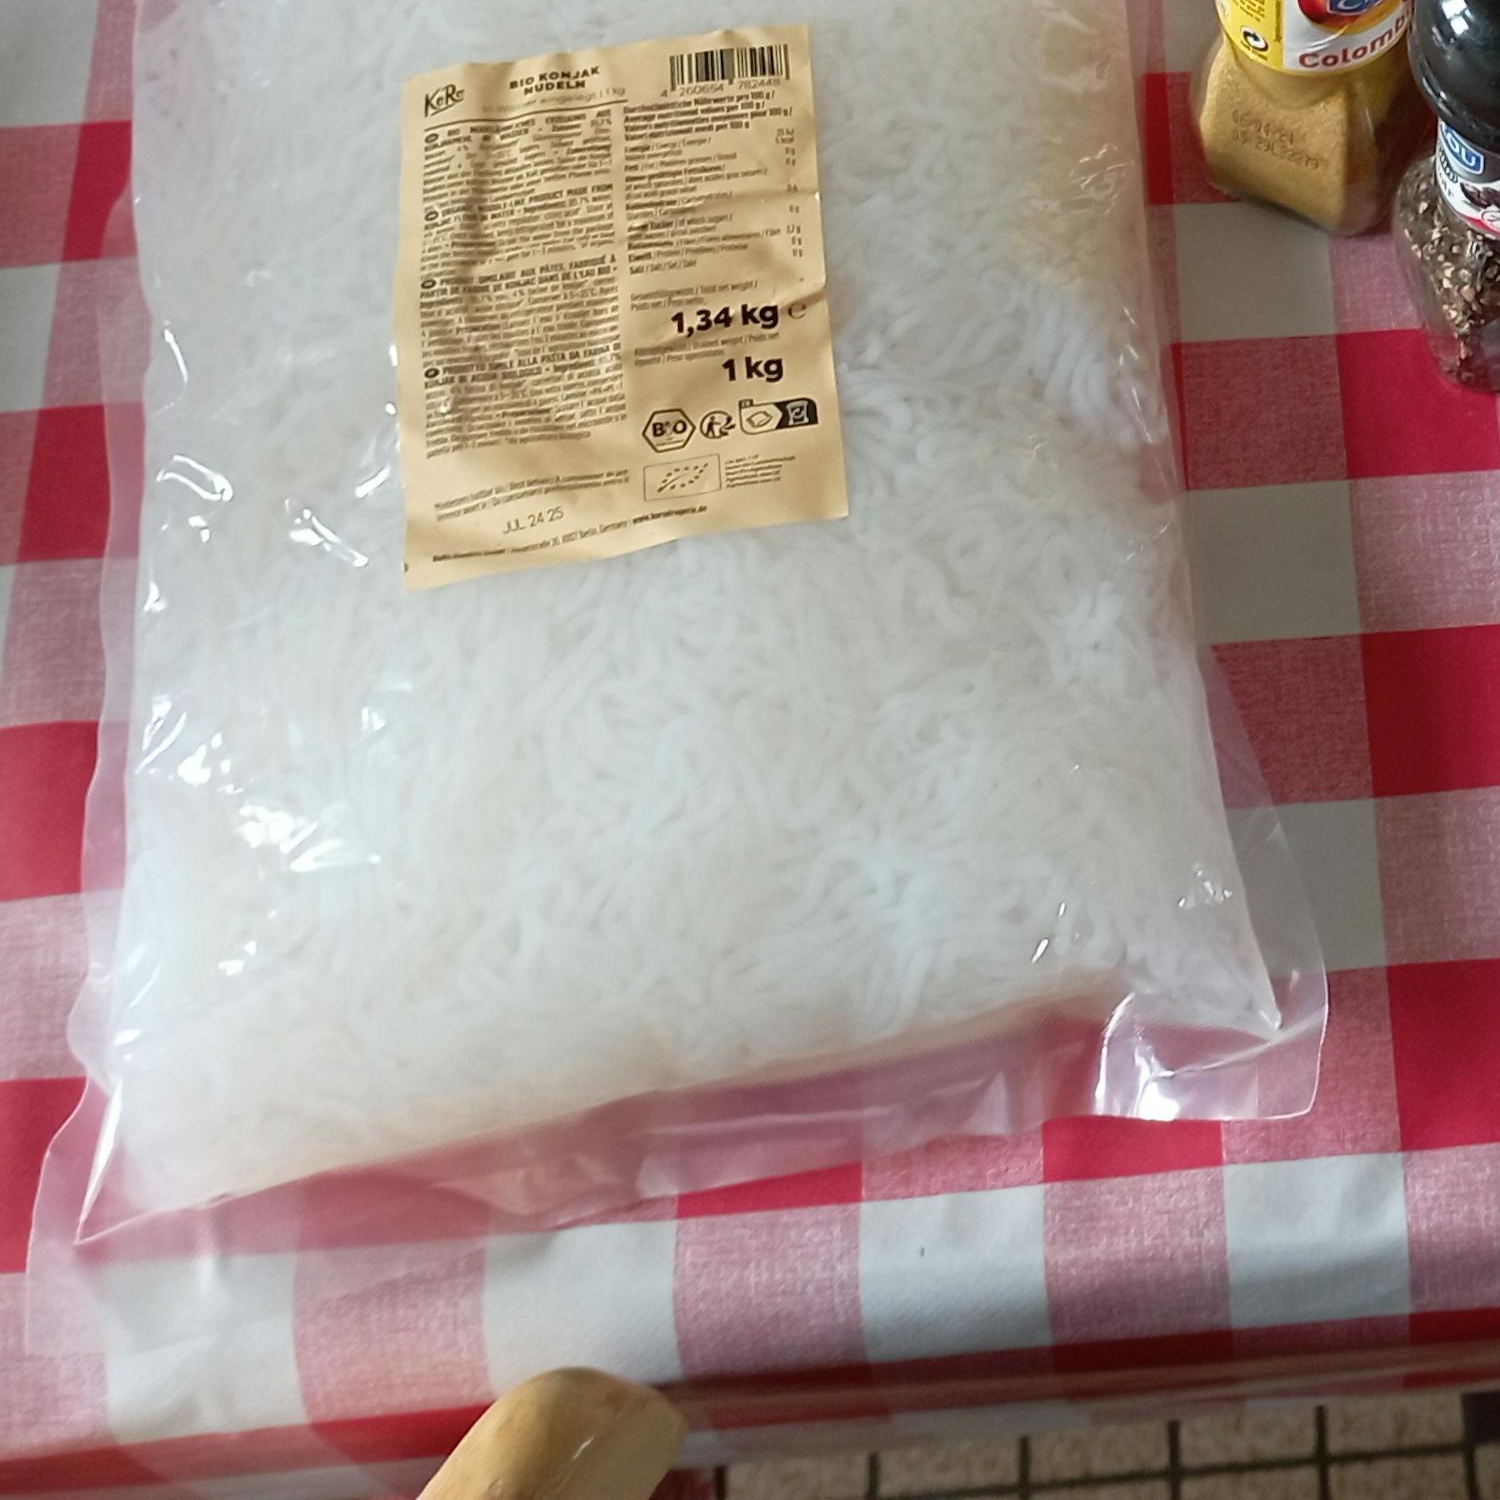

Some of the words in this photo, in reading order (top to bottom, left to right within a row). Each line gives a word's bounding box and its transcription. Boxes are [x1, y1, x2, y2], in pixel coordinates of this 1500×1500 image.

[509, 76, 535, 90] BIO
[539, 65, 600, 82] KONJAK
[523, 79, 586, 96] NUDELN
[672, 306, 734, 338] 1,34
[741, 304, 779, 330] kg
[722, 358, 737, 382] 1
[745, 356, 784, 383] kg
[502, 520, 525, 535] JUL
[528, 512, 545, 528] 24
[548, 506, 564, 521] 25
